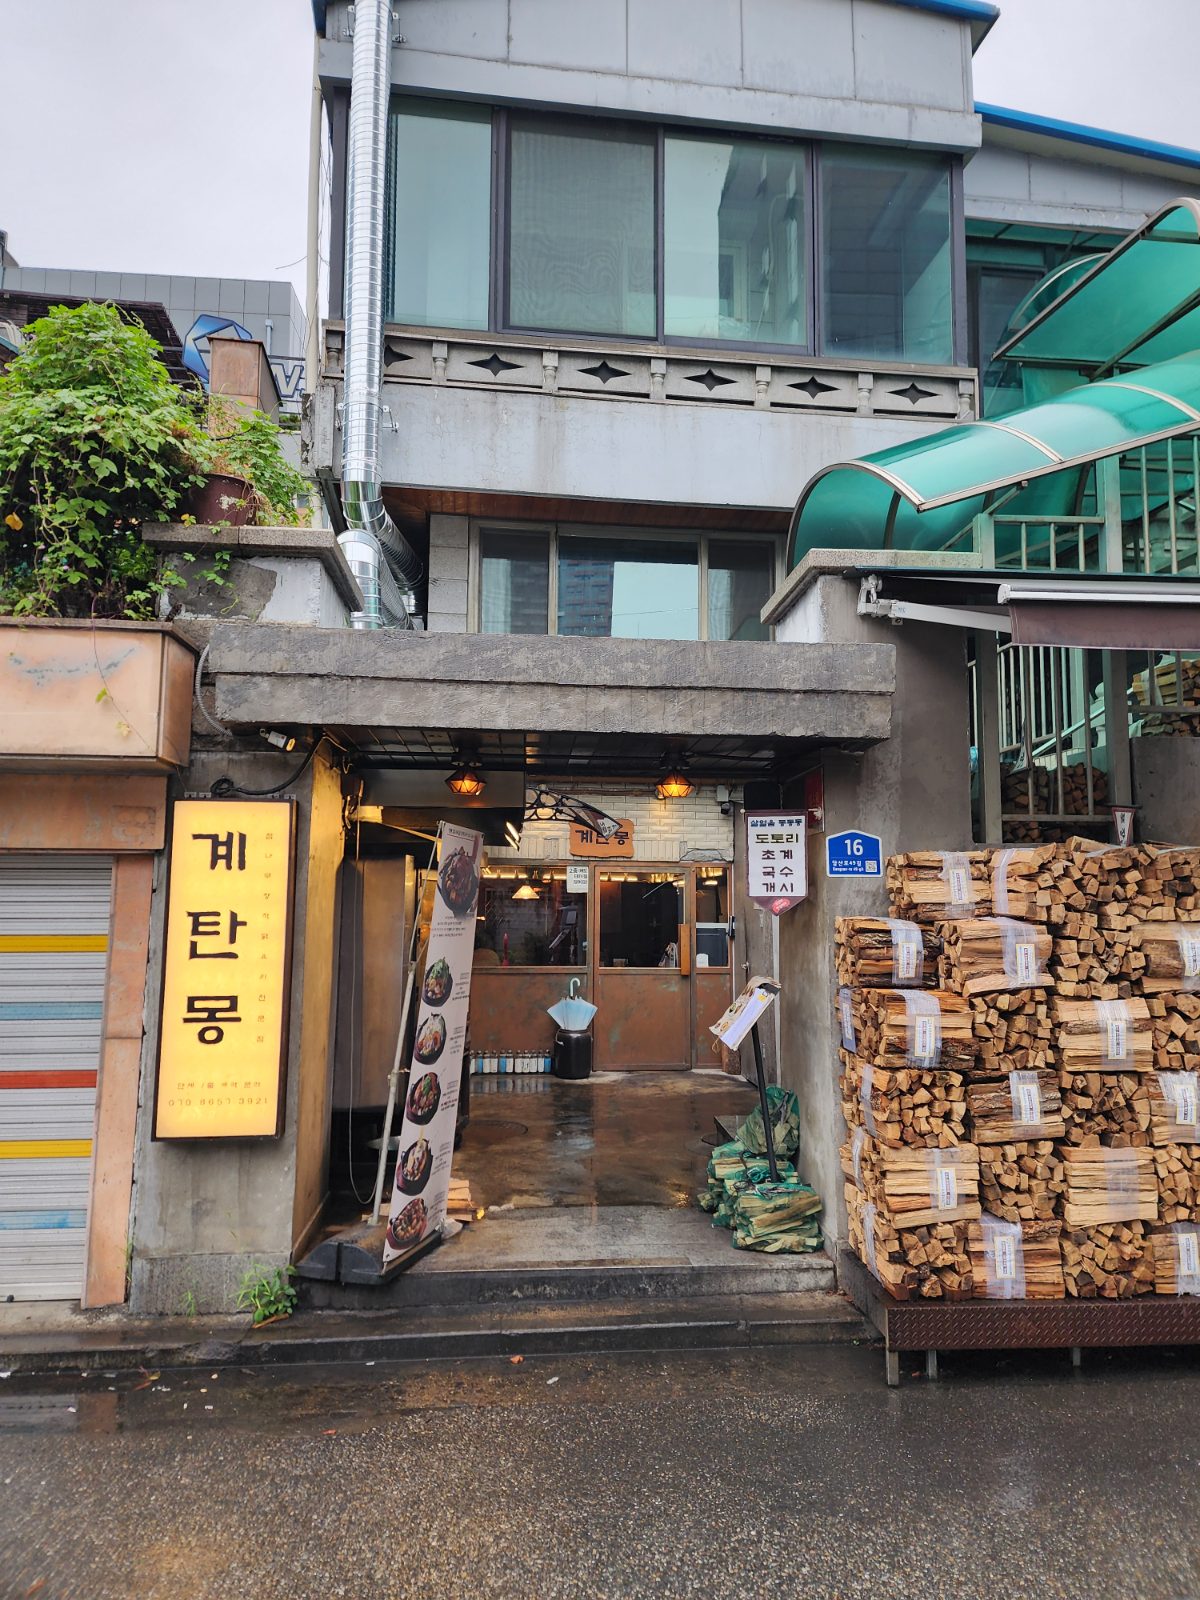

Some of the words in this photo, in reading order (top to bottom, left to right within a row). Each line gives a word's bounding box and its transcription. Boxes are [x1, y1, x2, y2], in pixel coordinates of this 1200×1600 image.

[755, 833, 798, 843] 도토리
[845, 839, 863, 855] 16
[762, 850, 792, 859] 초계
[762, 867, 793, 877] 국수
[762, 883, 793, 892] 개시
[182, 831, 247, 1045] 계탄몽
